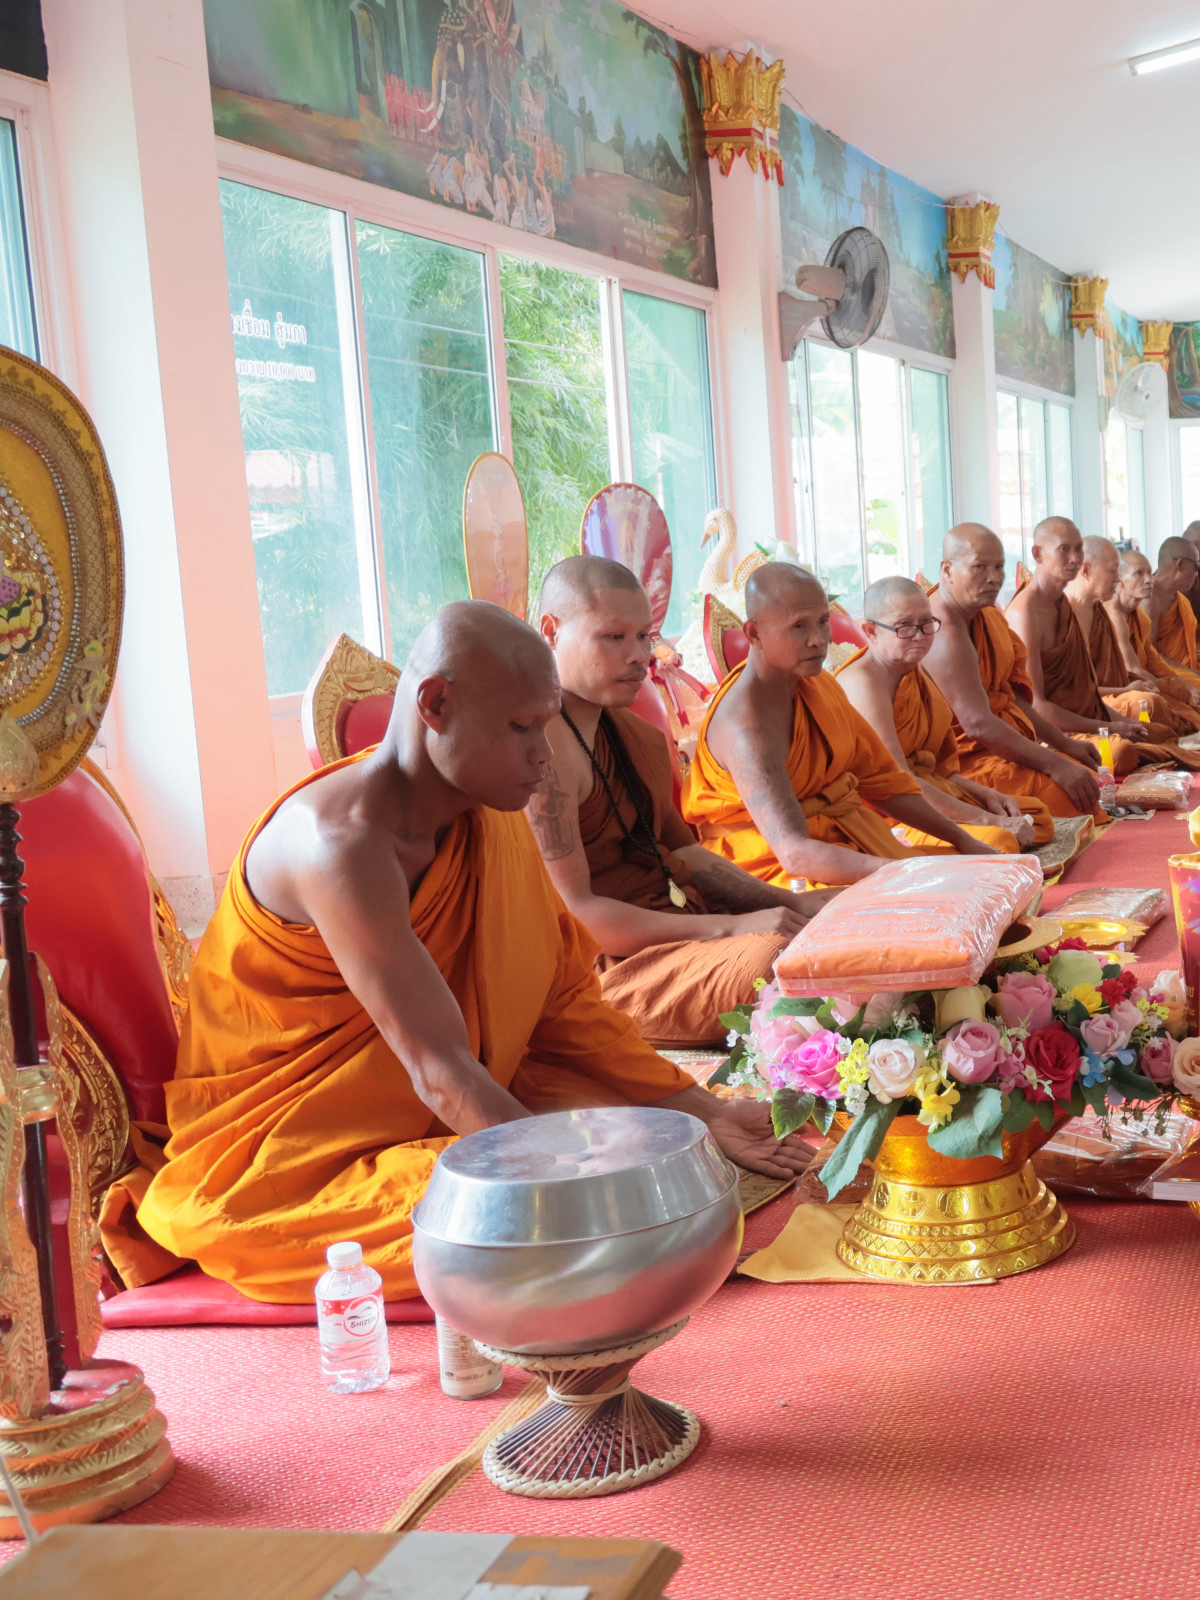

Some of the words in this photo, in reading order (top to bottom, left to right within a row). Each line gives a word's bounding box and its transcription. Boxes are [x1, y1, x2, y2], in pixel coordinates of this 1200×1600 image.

[265, 361, 296, 381] 10,000
[296, 365, 317, 382] บาท
[350, 1315, 377, 1329] SHIZEN
